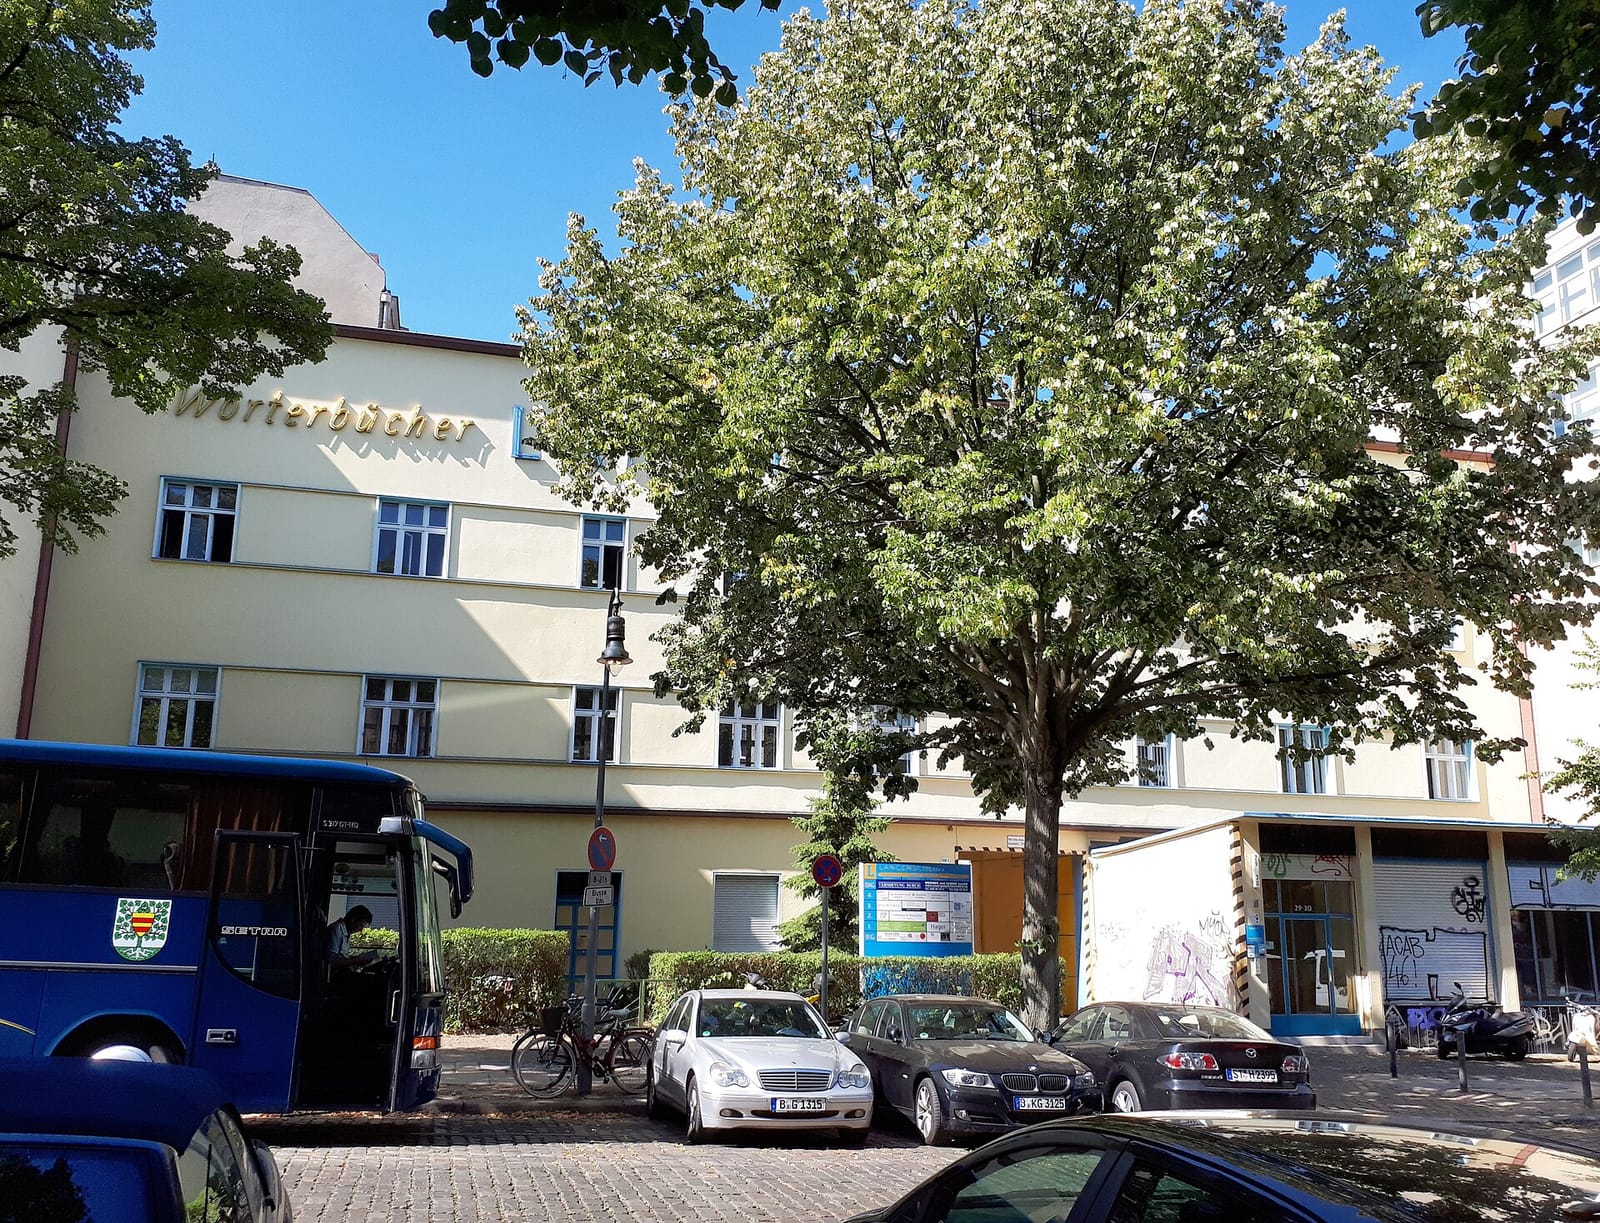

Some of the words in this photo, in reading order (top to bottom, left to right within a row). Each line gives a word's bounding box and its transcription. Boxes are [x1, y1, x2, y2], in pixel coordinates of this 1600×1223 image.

[221, 926, 288, 936] SETRA
[1386, 935, 1425, 958] ACAB
[1256, 1070, 1276, 1081] 2395
[779, 1099, 786, 1109] B
[791, 1099, 798, 1110] G
[800, 1099, 822, 1110] 1315
[1031, 1098, 1043, 1109] KG
[1045, 1099, 1065, 1109] 3125
